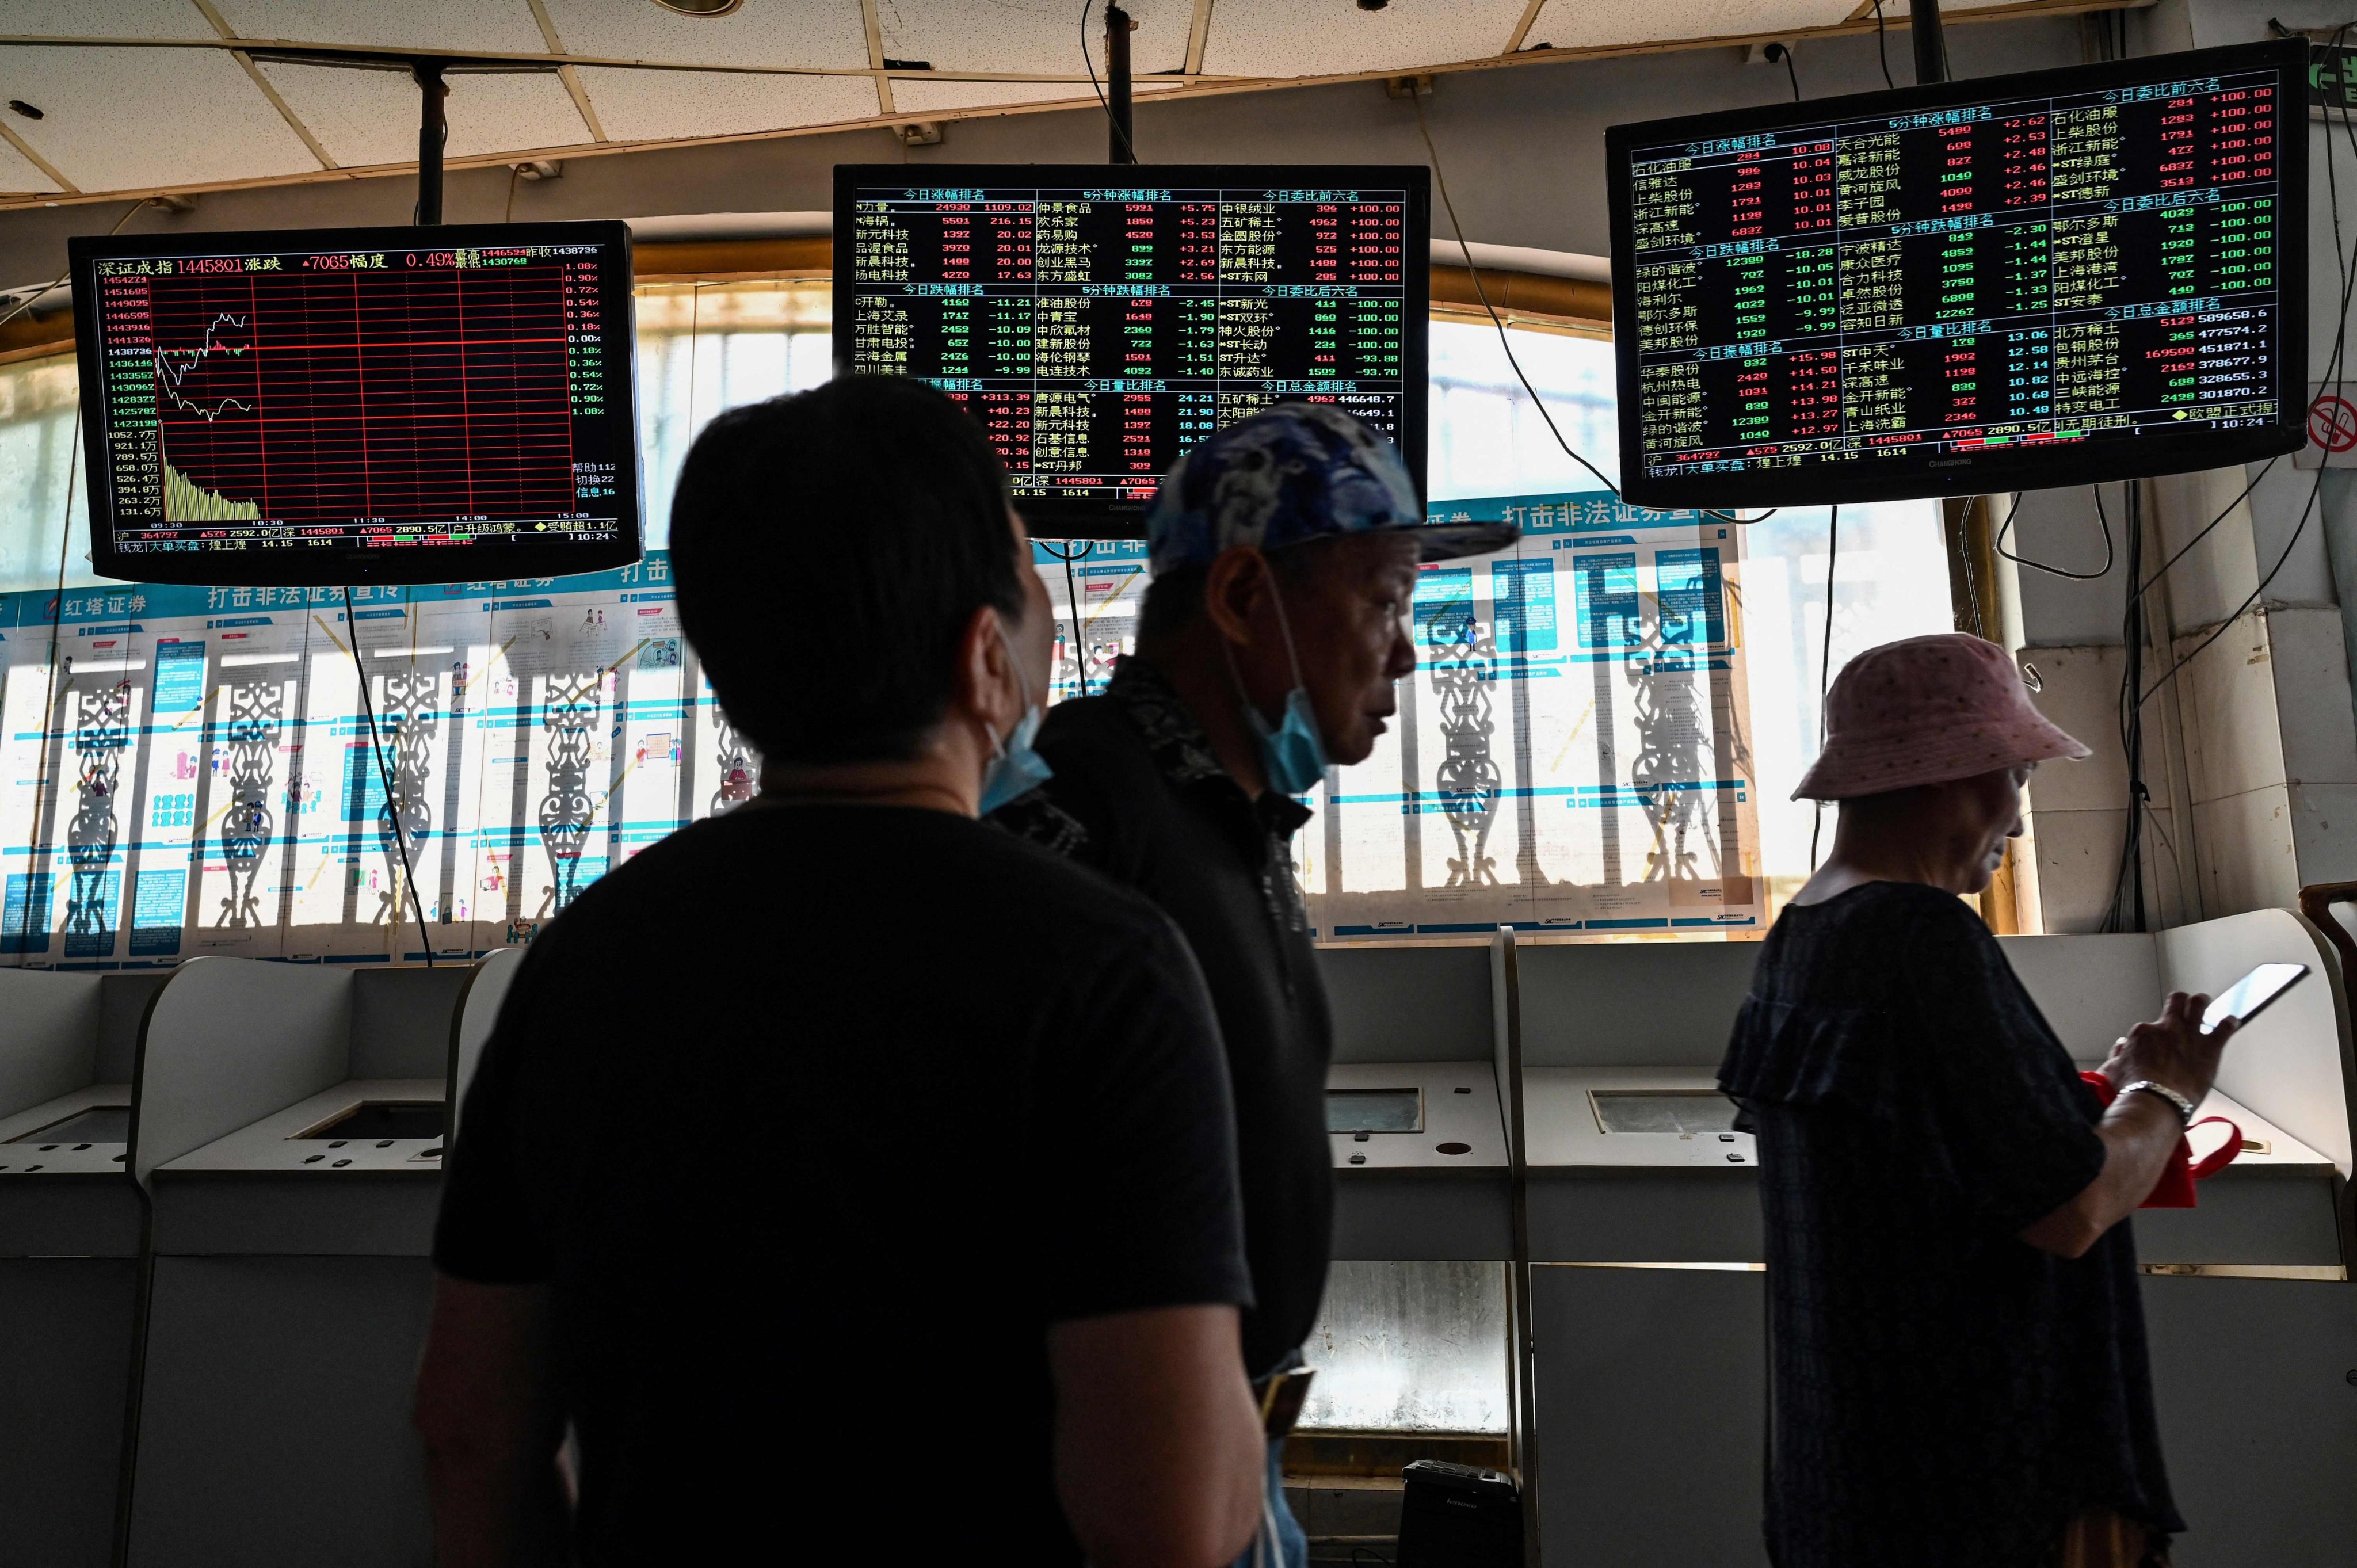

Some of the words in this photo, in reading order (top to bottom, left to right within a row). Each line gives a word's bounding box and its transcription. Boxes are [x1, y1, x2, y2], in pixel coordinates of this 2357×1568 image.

[2103, 78, 2220, 104] 今日委比前六名
[1889, 107, 1992, 129] 5分钟涨幅排名
[1685, 135, 1776, 155] 今日涨幅排名
[904, 189, 985, 200] 今日涨幅排名
[1084, 190, 1171, 201] 5分钟涨幅排名
[1263, 191, 1359, 201] 今日委比前六名
[2104, 188, 2220, 212] 今日委比后六名
[1891, 214, 1994, 235] 5分钟跌幅排名
[856, 229, 909, 240] 新元科技
[526, 247, 551, 258] 昨收
[552, 246, 597, 254] 1438736
[856, 243, 907, 253] 品渥食品
[1689, 238, 1779, 258] 今日跌幅排名
[98, 260, 172, 276] 深证成指
[177, 259, 243, 273] 1445801
[243, 255, 282, 270] 涨跌
[309, 255, 349, 269] 7065
[349, 252, 388, 268] 幅度
[406, 251, 456, 266] 0.49%
[856, 256, 909, 267] 新晨科技
[856, 270, 908, 281] 扬电科技
[902, 284, 983, 295] 今日跌幅排名
[1082, 285, 1170, 296] 5分钟跌幅排名
[1262, 286, 1357, 297] 今日委比后六名
[1036, 297, 1090, 308] 准油股份
[2104, 297, 2220, 320] 今日总金额排名
[1037, 311, 1077, 322] 中青宝
[2054, 322, 2120, 339] 北方稀土
[2160, 316, 2194, 326] 5129
[2198, 309, 2267, 323] 589658.6
[1037, 325, 1090, 336] 中欣氟材
[1898, 320, 1992, 340] 今日量比排名
[1036, 338, 1090, 349] 建新股份
[2054, 337, 2120, 353] 包钢股份
[2169, 331, 2194, 341] 365
[2199, 325, 2267, 338] 477574.2
[1693, 341, 1782, 360] 今日振幅排名
[2054, 353, 2119, 368] 贵州茅台
[2145, 347, 2194, 358] 169500
[2199, 340, 2267, 353] 451871.1
[1036, 352, 1090, 363] 海伦钢琴
[1036, 365, 1090, 376] 电连技术
[2057, 367, 2120, 384] 中远海控
[2161, 362, 2194, 372] 2169
[2199, 355, 2267, 369] 378677.9
[1085, 380, 1166, 391] 今日量比排名
[1261, 381, 1356, 392] 今日总金额排名
[2055, 383, 2120, 398] 三峡能源
[2169, 377, 2194, 387] 688
[2199, 371, 2267, 384] 328655.3
[2055, 398, 2120, 414] 特变电工
[2161, 392, 2194, 403] 2498
[2199, 386, 2267, 399] 301870.2
[109, 430, 157, 440] 1052.7万
[115, 441, 157, 451] 921.1万
[116, 452, 158, 461] 789.5万
[116, 464, 159, 472] 658.0万
[1929, 459, 1971, 467] CHANGHONG
[117, 475, 159, 483] 526.4万
[118, 486, 160, 494] 394.8万
[119, 497, 161, 505] 263.2万
[121, 508, 162, 516] 131.6万
[230, 527, 281, 539] 2592.0亿
[282, 527, 296, 538] 深
[395, 523, 447, 535] 2890.5亿
[117, 542, 143, 552] 钱龙
[208, 539, 247, 550] 煌上煌
[261, 539, 292, 547] 14.15
[577, 532, 609, 540] 10:24
[64, 594, 146, 616] 红塔证券
[1446, 1498, 1478, 1509] lenovo
